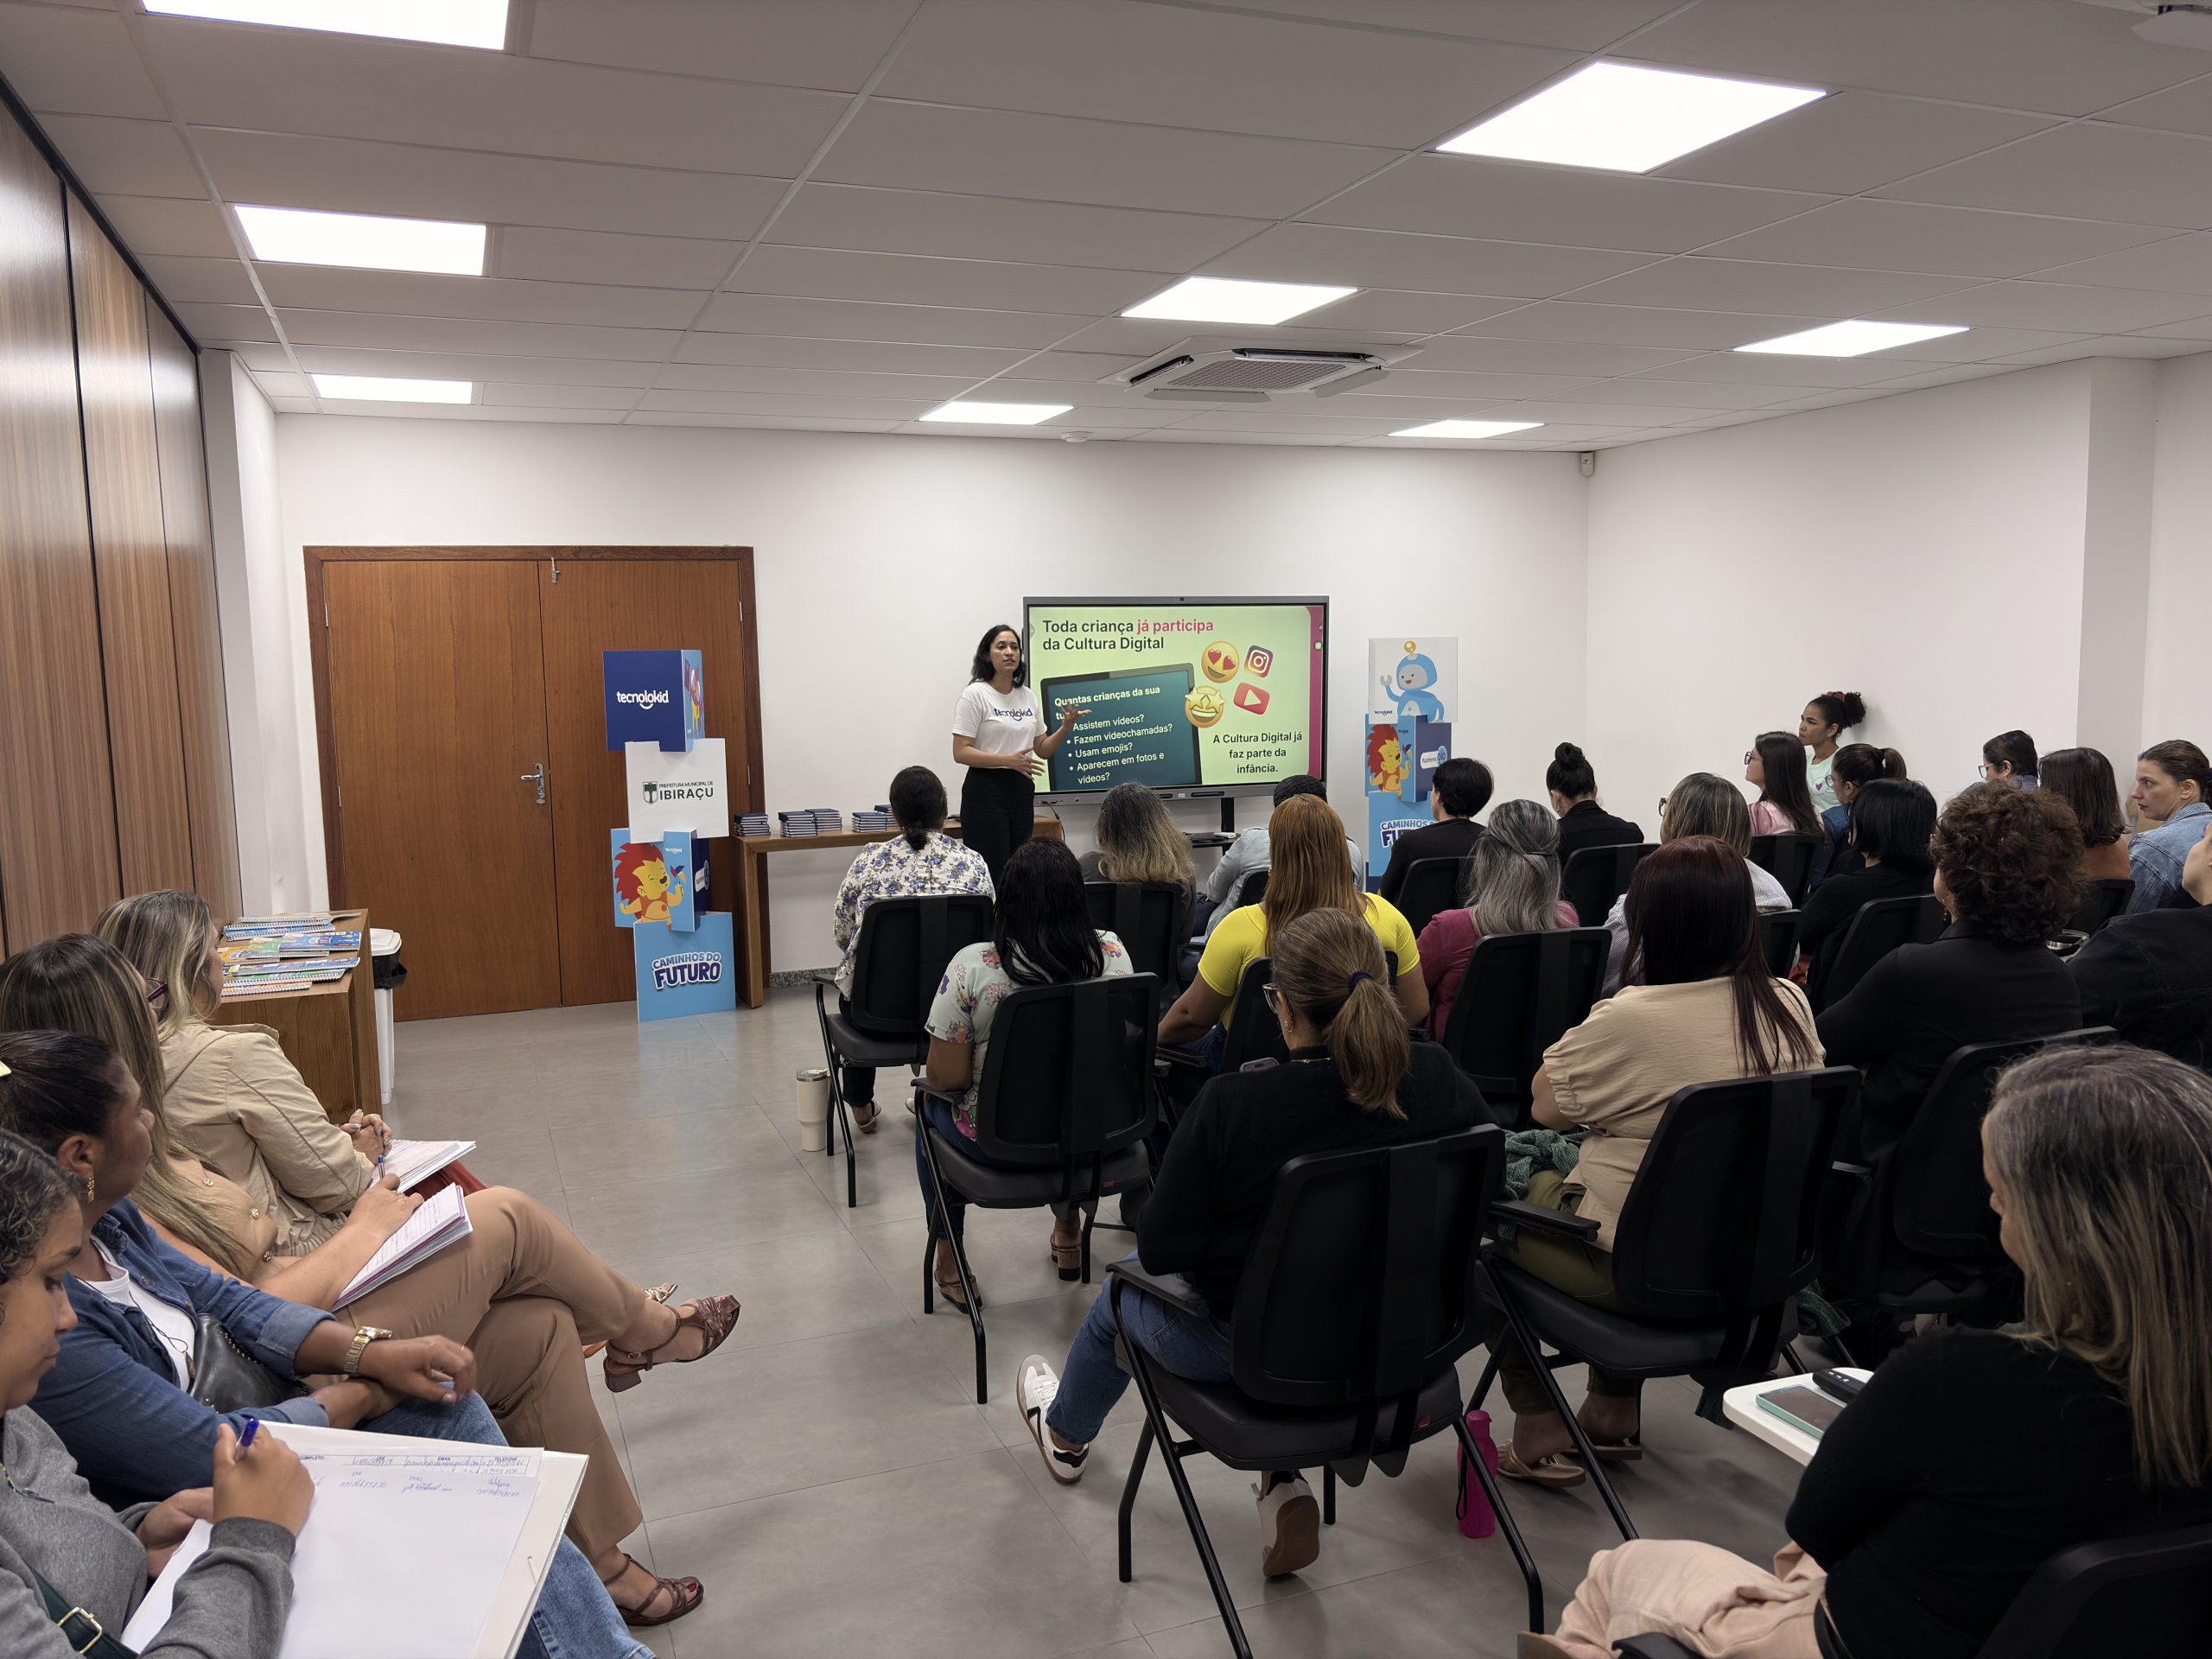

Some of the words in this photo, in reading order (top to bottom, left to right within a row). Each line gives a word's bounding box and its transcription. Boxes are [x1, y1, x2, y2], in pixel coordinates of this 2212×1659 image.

[1042, 620, 1077, 632] Toda
[1081, 620, 1134, 636] criança
[1136, 619, 1149, 635] já
[1153, 619, 1214, 634] participa
[1042, 638, 1060, 651] da
[1064, 637, 1116, 650] Cultura
[1120, 637, 1164, 652] Digital
[616, 690, 669, 703] tecnolokid
[1054, 696, 1091, 707] Quantas
[1093, 691, 1131, 702] crianças
[1132, 688, 1144, 696] da
[1145, 686, 1160, 695] sua
[1072, 719, 1110, 732] Assistem
[1112, 714, 1145, 727] vídeos?
[1074, 734, 1102, 745] Fazem
[1103, 723, 1173, 741] videochamadas?
[1212, 734, 1220, 743] A
[1223, 734, 1259, 743] Cultura
[1261, 732, 1292, 744] Digital
[1293, 731, 1302, 743] já
[1075, 747, 1100, 759] Usam
[1101, 742, 1134, 756] emojis?
[1229, 749, 1244, 759] faz
[1246, 748, 1273, 760] parte
[1274, 748, 1287, 757] da
[1077, 759, 1120, 772] Aparecem
[1121, 755, 1135, 764] em
[1135, 752, 1157, 763] fotos
[1236, 763, 1279, 773] infância.
[1077, 772, 1110, 785] vídeos?
[659, 787, 714, 801] IBIRAÇU
[1381, 819, 1427, 830] CAMINHOS
[652, 953, 705, 969] CAMINHOS
[706, 953, 721, 962] DO
[654, 962, 721, 988] FUTURO
